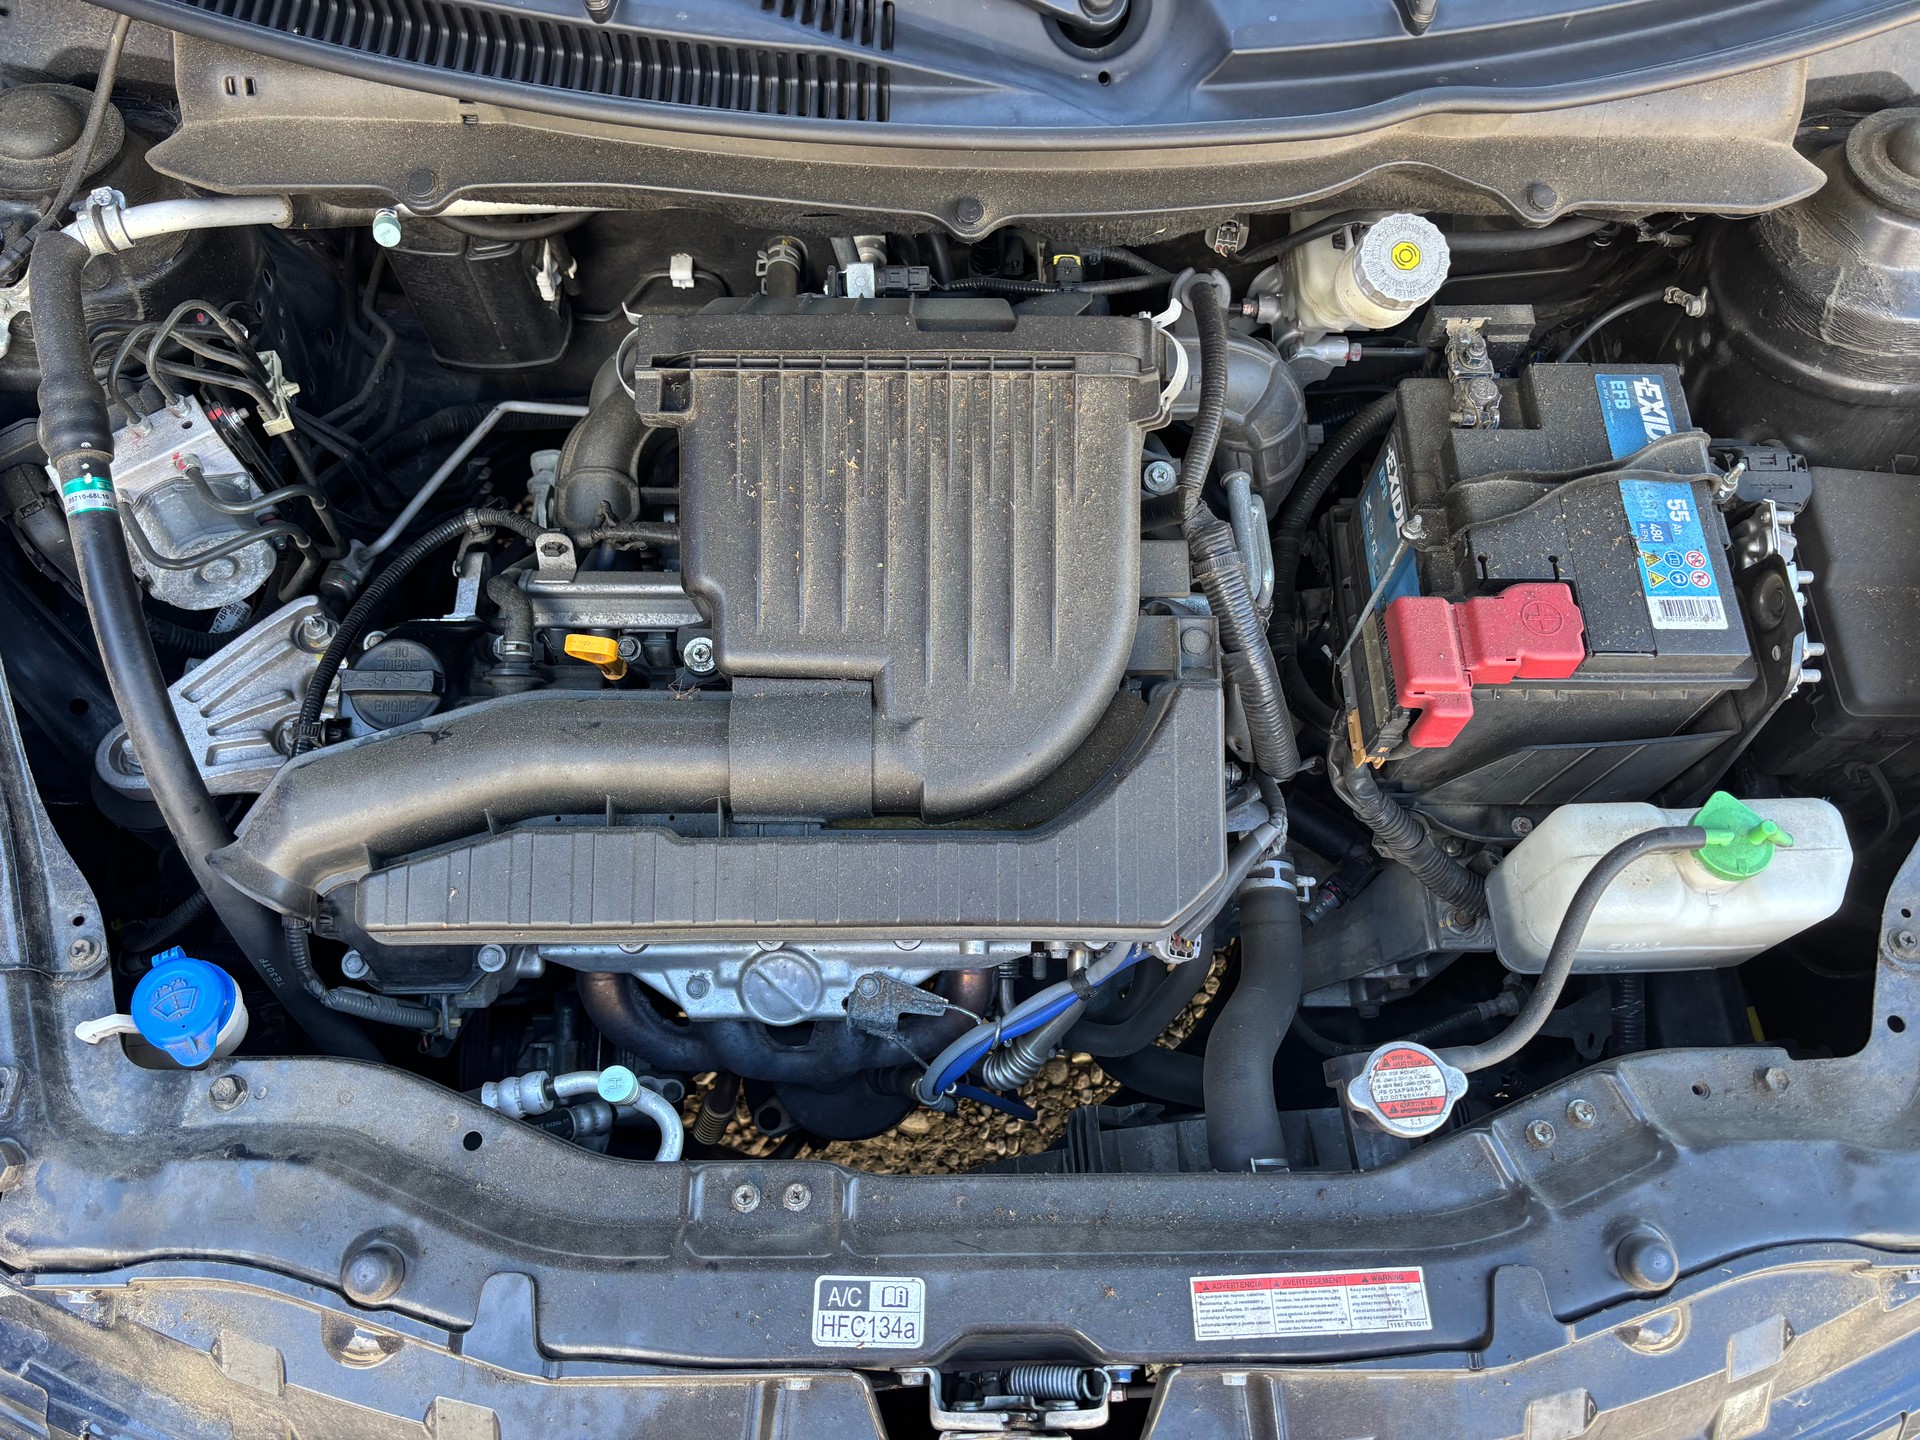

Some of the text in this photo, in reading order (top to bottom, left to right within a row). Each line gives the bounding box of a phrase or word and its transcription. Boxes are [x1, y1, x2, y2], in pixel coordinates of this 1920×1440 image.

[1610, 381, 1632, 410] EFB
[1633, 377, 1672, 444] EXID
[1378, 465, 1388, 501] EFB
[1667, 499, 1690, 535] 55 Ah
[1650, 523, 1664, 542] 480
[374, 700, 418, 712] ENGINE
[1212, 1281, 1262, 1290] ADVERTENCIA
[1283, 1277, 1343, 1286] AVERTISSEMENT
[827, 1286, 862, 1307] A/C
[821, 1314, 915, 1339] HFC134a
